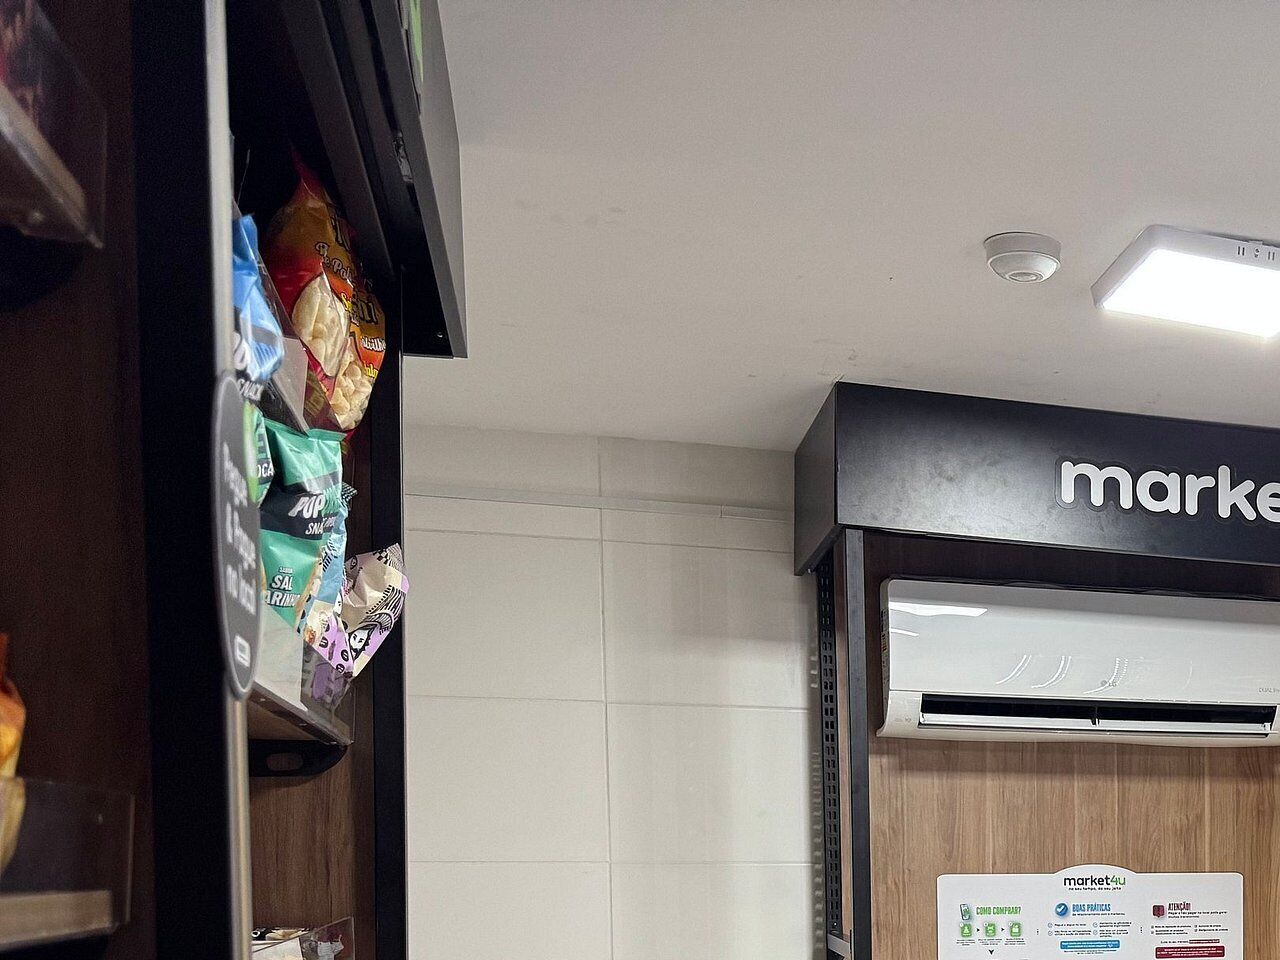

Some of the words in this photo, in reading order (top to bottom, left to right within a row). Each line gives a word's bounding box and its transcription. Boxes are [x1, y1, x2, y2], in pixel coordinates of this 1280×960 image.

[288, 495, 325, 518] POP
[272, 575, 292, 590] SAL
[1064, 875, 1126, 886] market4u
[976, 906, 991, 915] COMO
[993, 906, 1022, 915] COMPRAR?
[1072, 904, 1085, 912] BOAS
[1087, 902, 1111, 912] PRÁTICAS
